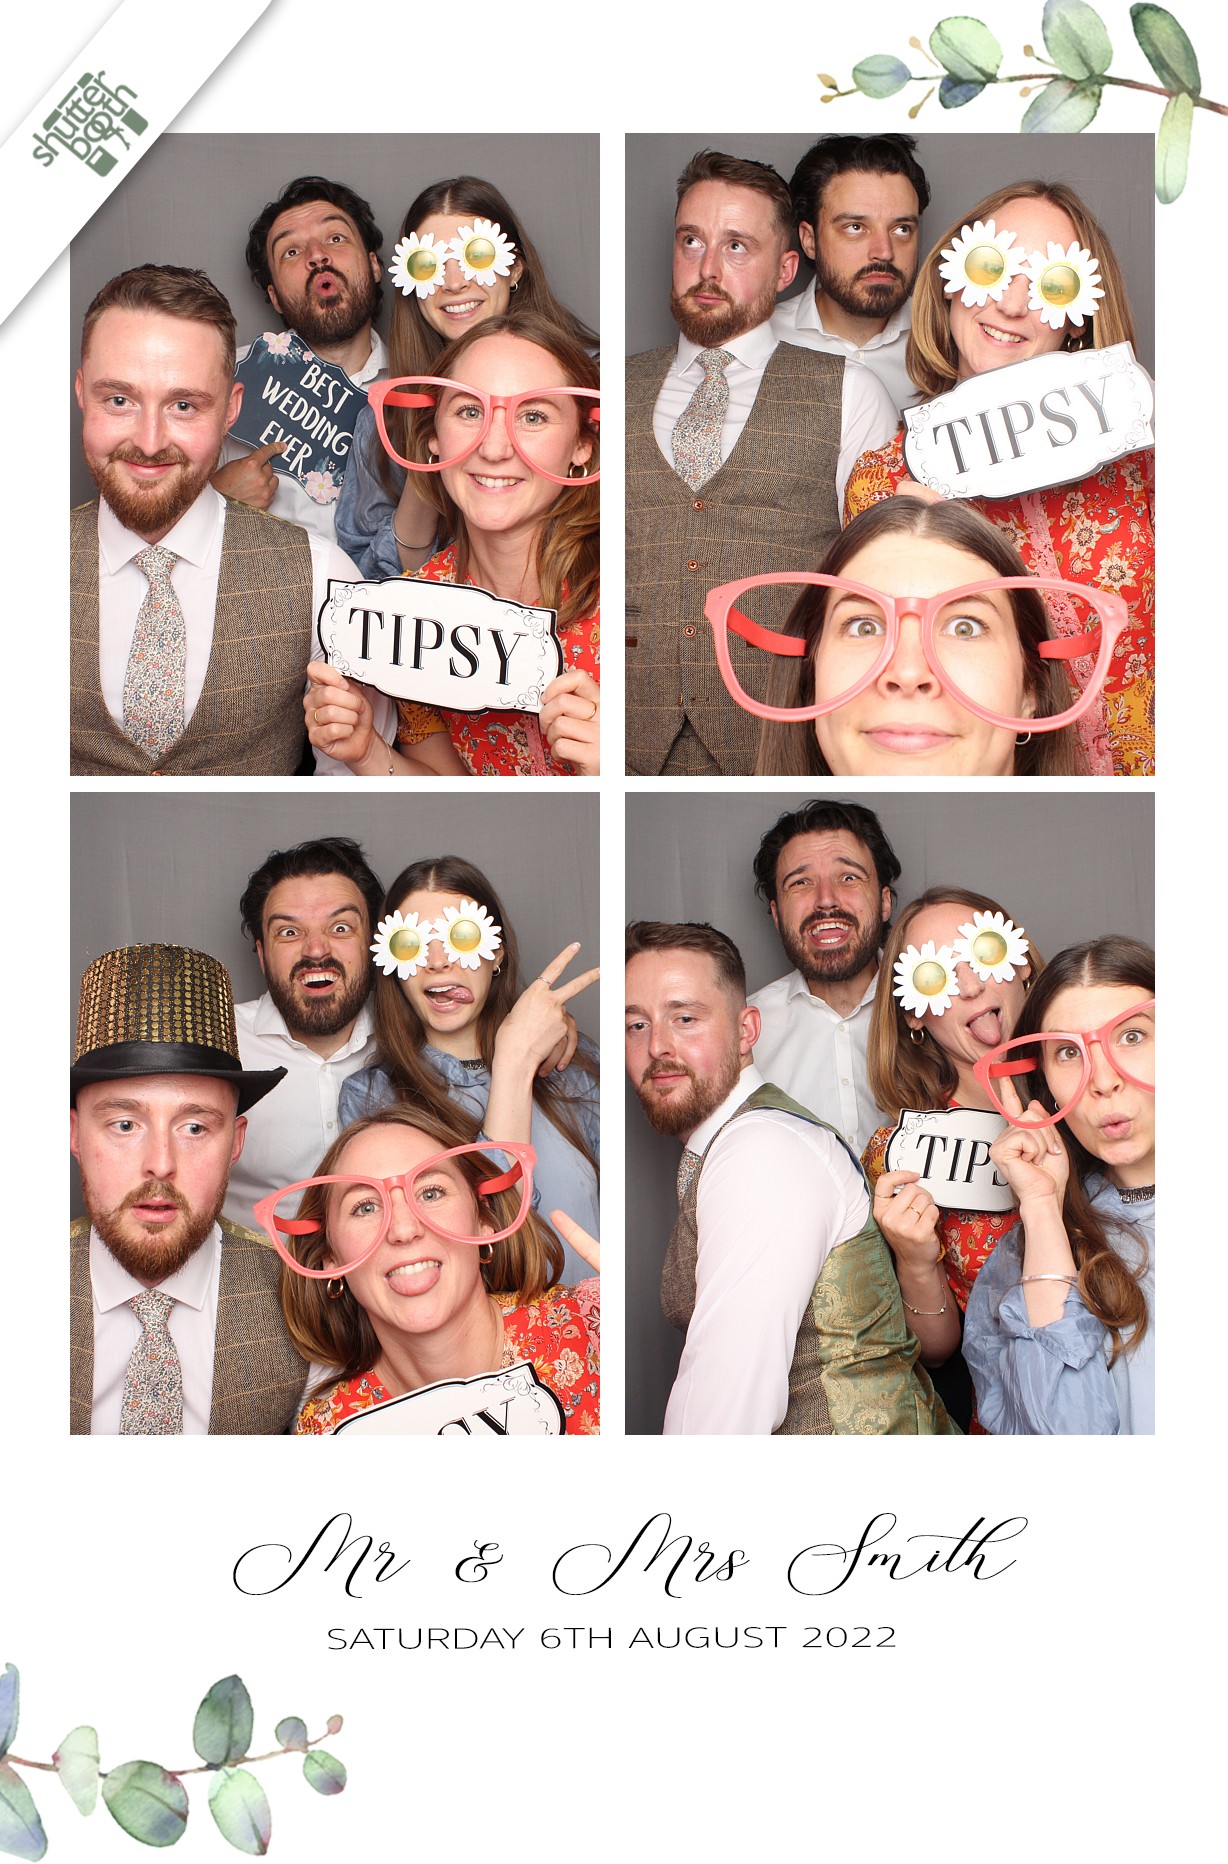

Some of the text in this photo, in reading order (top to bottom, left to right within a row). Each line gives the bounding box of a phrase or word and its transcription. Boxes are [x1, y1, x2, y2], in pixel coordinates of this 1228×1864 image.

[261, 375, 353, 456] WEDDING
[299, 363, 354, 414] BEST
[931, 373, 1114, 475] TIPSY
[258, 420, 313, 477] EVER
[348, 606, 528, 686] TIPSY
